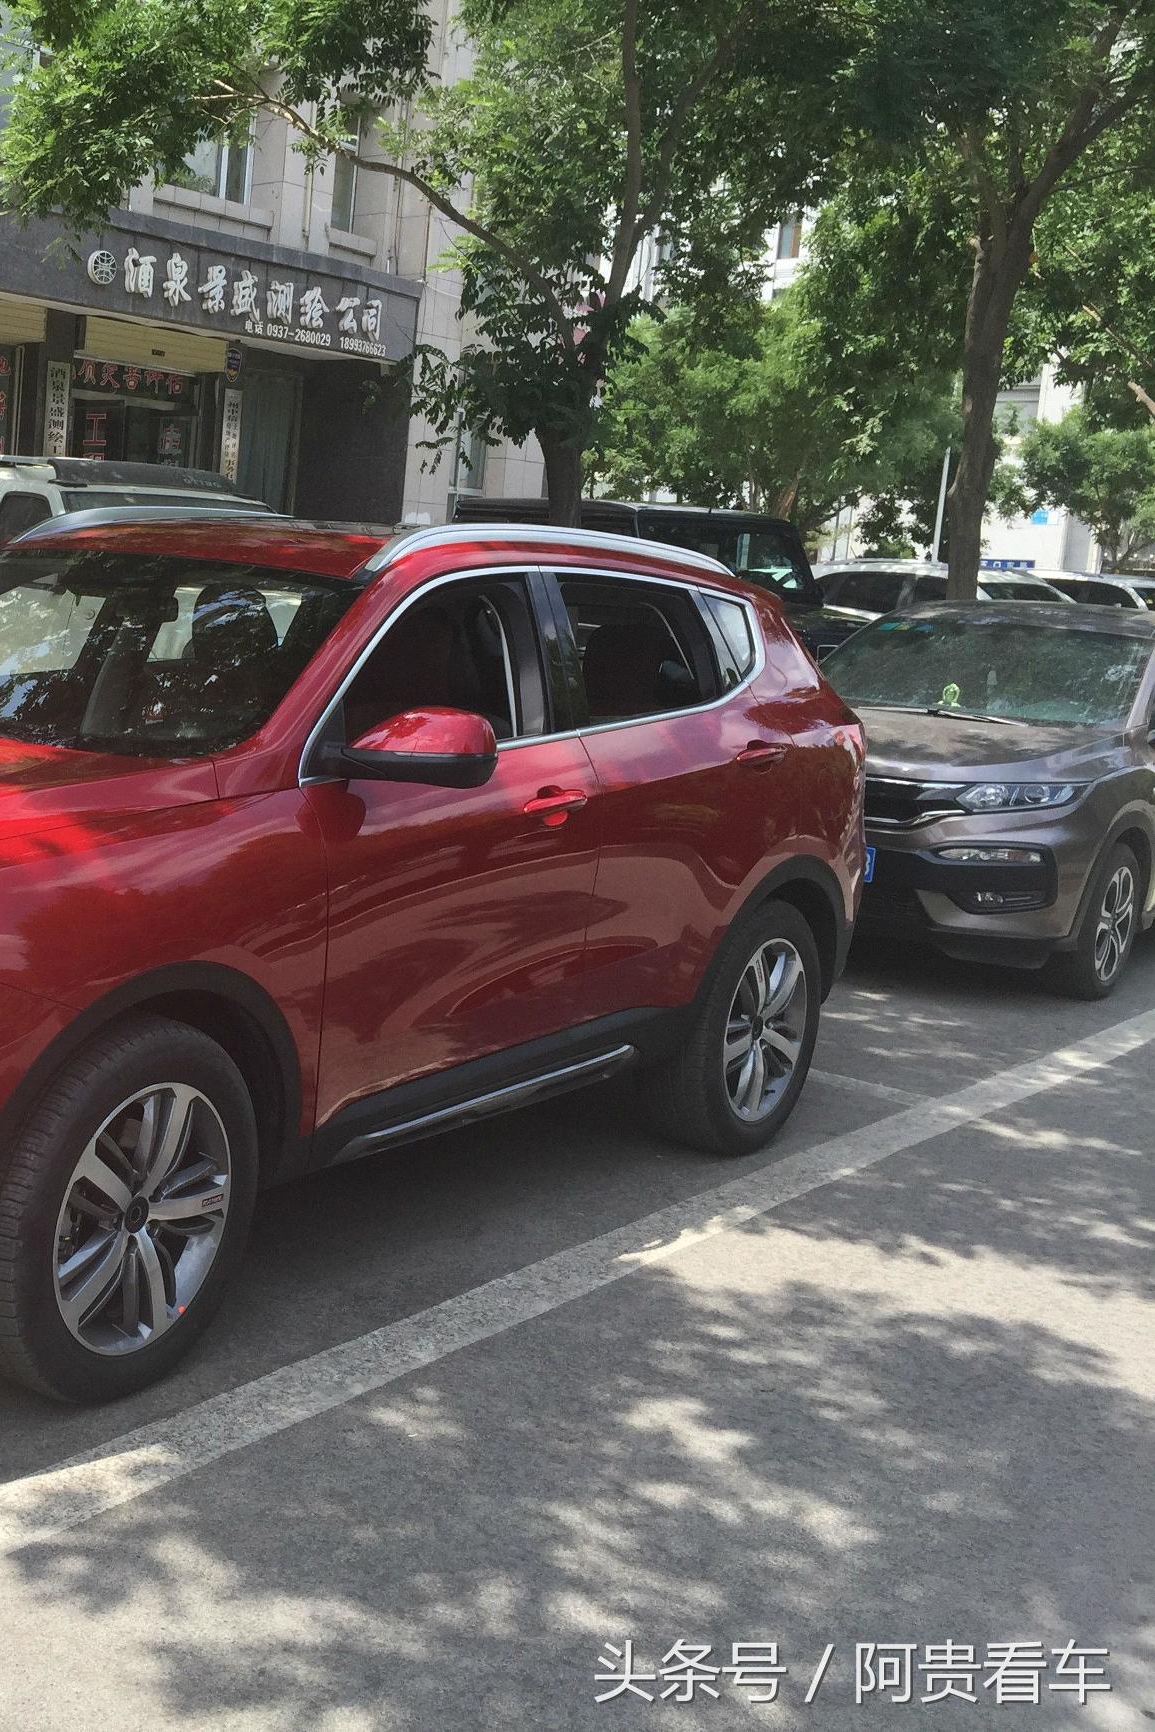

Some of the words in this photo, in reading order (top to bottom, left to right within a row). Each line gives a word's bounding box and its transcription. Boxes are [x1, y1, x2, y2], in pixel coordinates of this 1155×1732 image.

[124, 247, 382, 341] 酒泉景盛测绘公司
[245, 320, 264, 335] 电话
[267, 323, 331, 346] 0937-2680029
[72, 359, 184, 395] 质灾害评估
